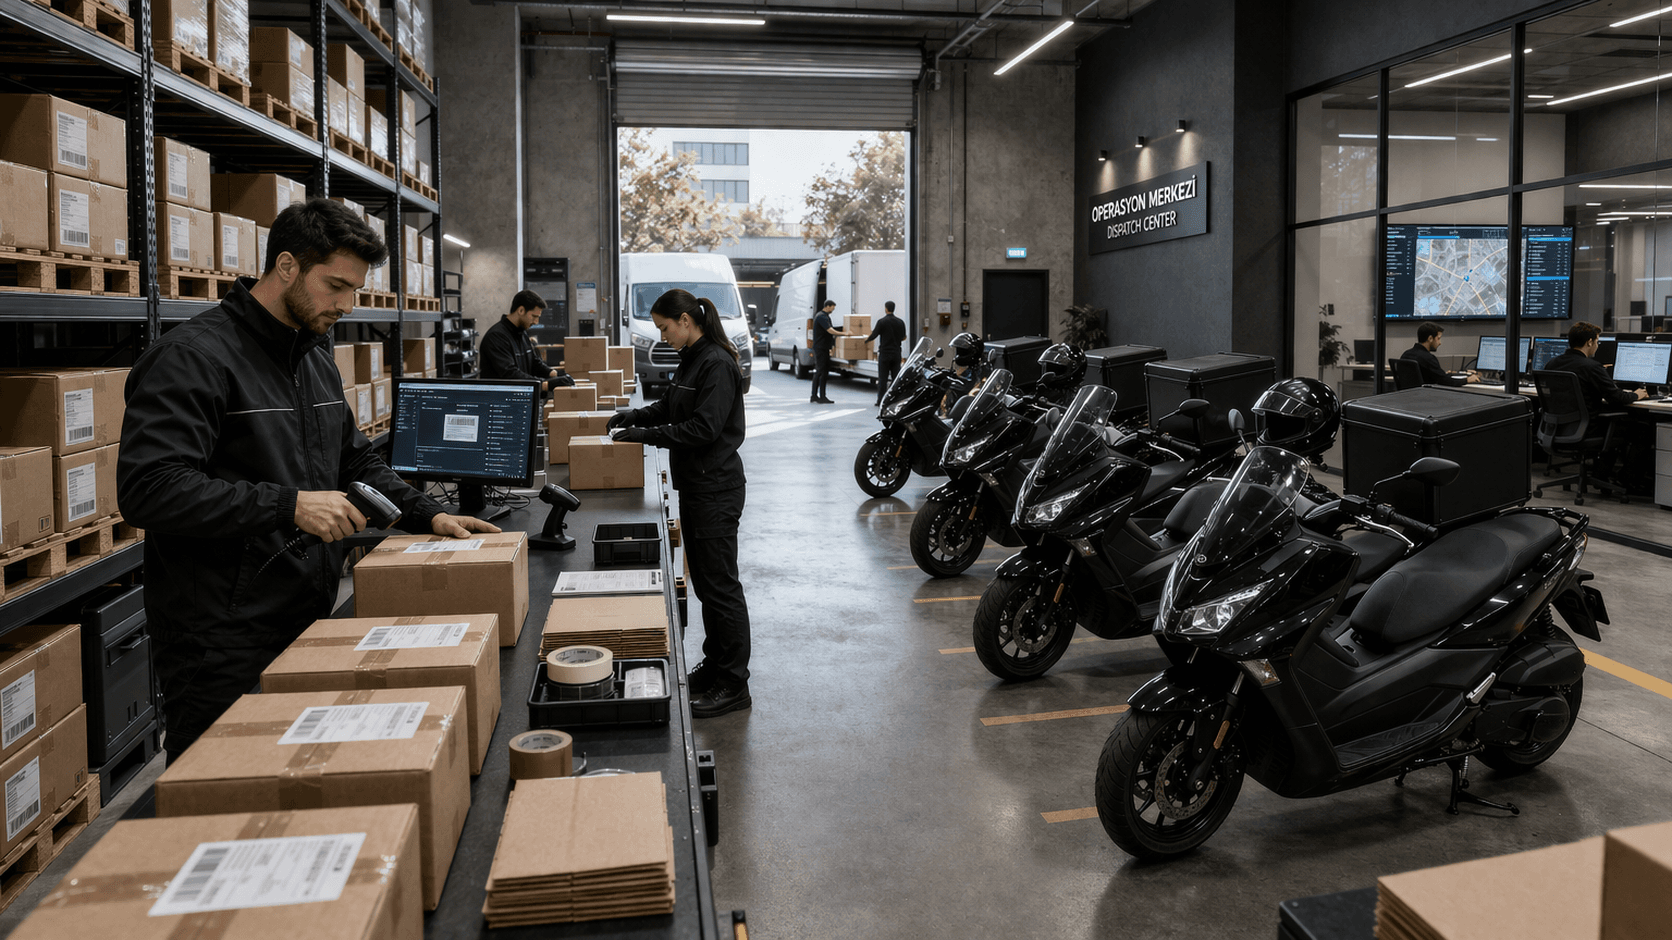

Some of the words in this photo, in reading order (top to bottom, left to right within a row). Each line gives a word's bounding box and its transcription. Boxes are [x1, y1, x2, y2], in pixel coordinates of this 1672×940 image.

[1092, 192, 1146, 223] OPERASYON
[1148, 174, 1197, 208] MERKEZİ
[1107, 218, 1142, 239] DISPATCH
[1143, 210, 1177, 232] CENTER
